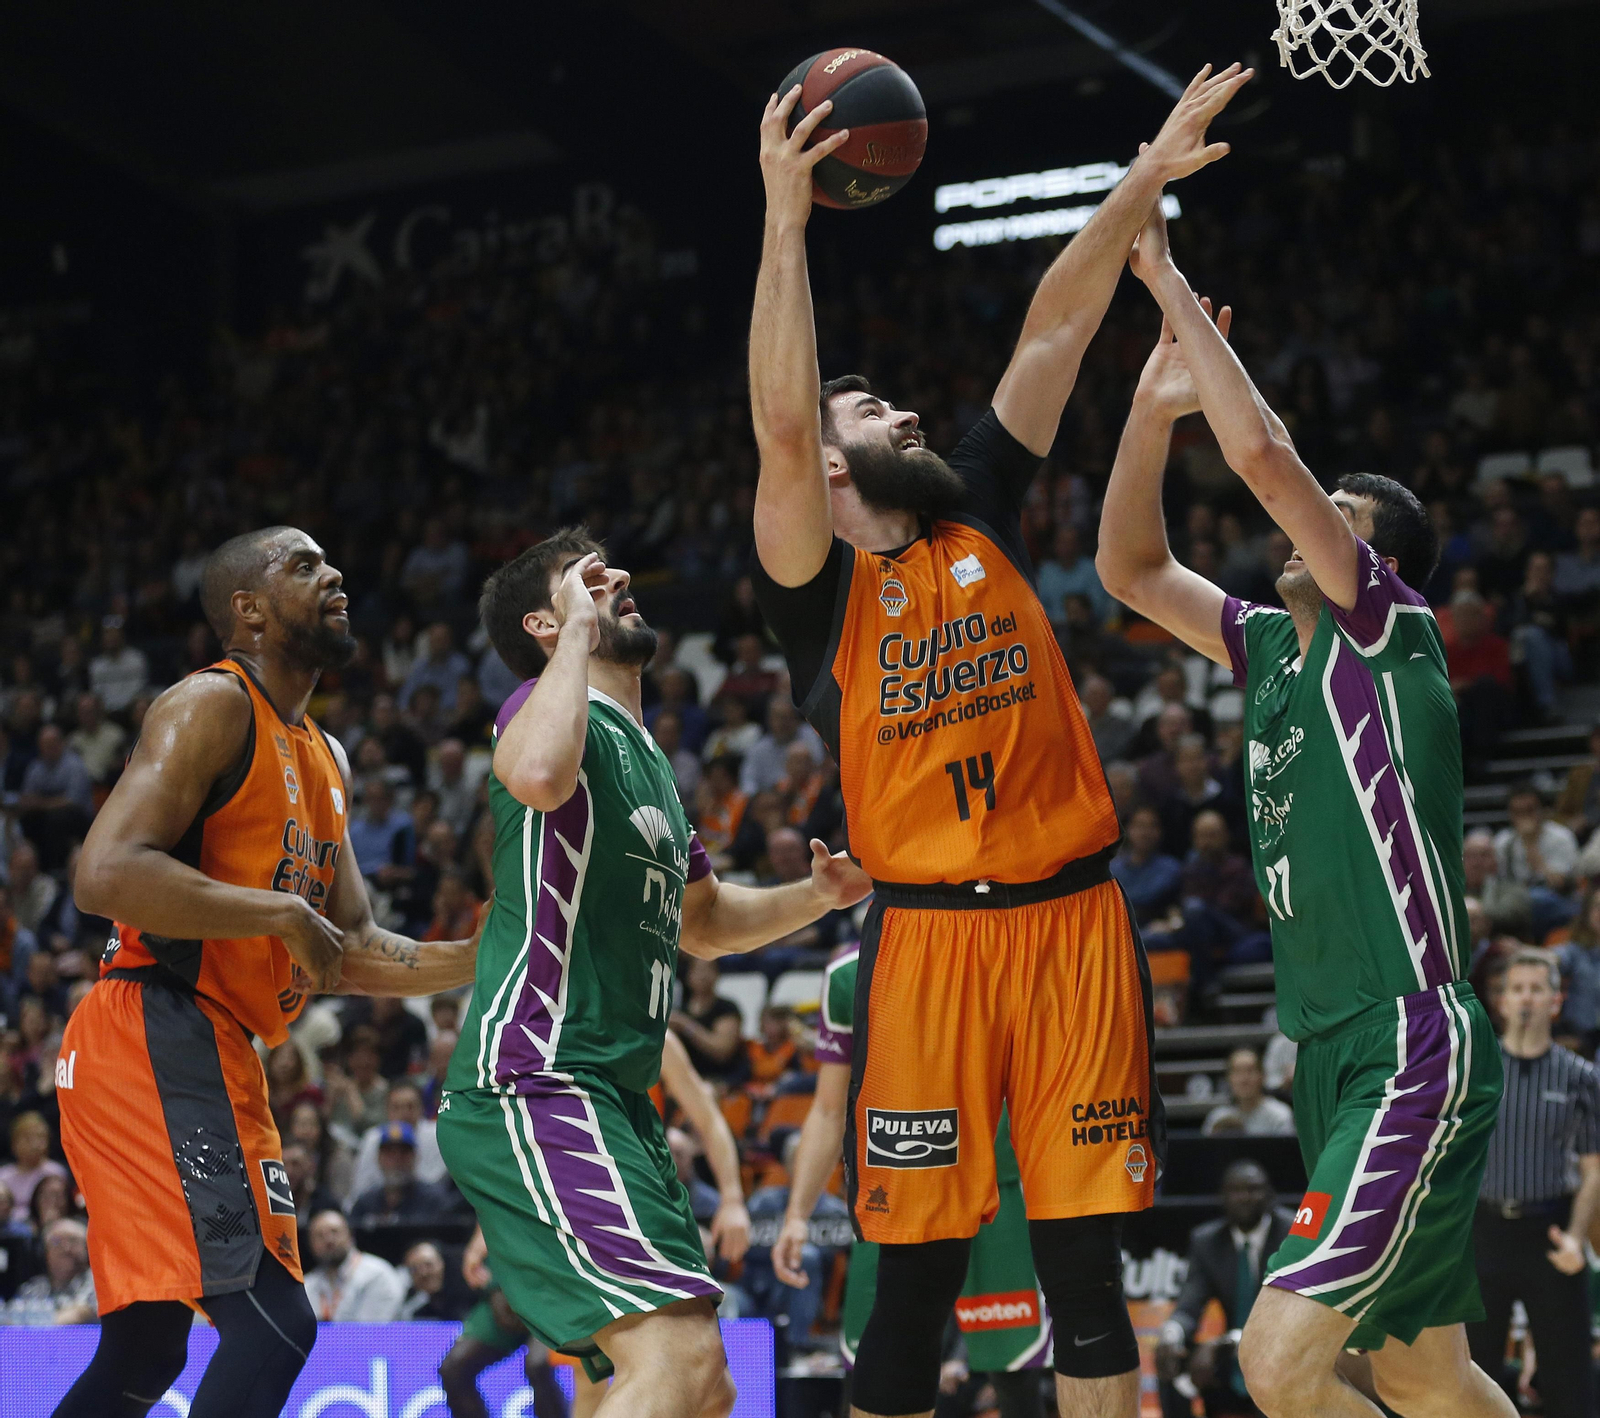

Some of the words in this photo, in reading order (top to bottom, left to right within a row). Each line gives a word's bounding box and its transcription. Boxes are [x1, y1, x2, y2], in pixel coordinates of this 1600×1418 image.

[878, 612, 988, 672] Culura
[991, 611, 1018, 637] del
[877, 680, 1037, 745] @VaenciaBasket
[945, 751, 996, 822] 14
[649, 958, 671, 1022] 11
[872, 1116, 953, 1136] PULEVA
